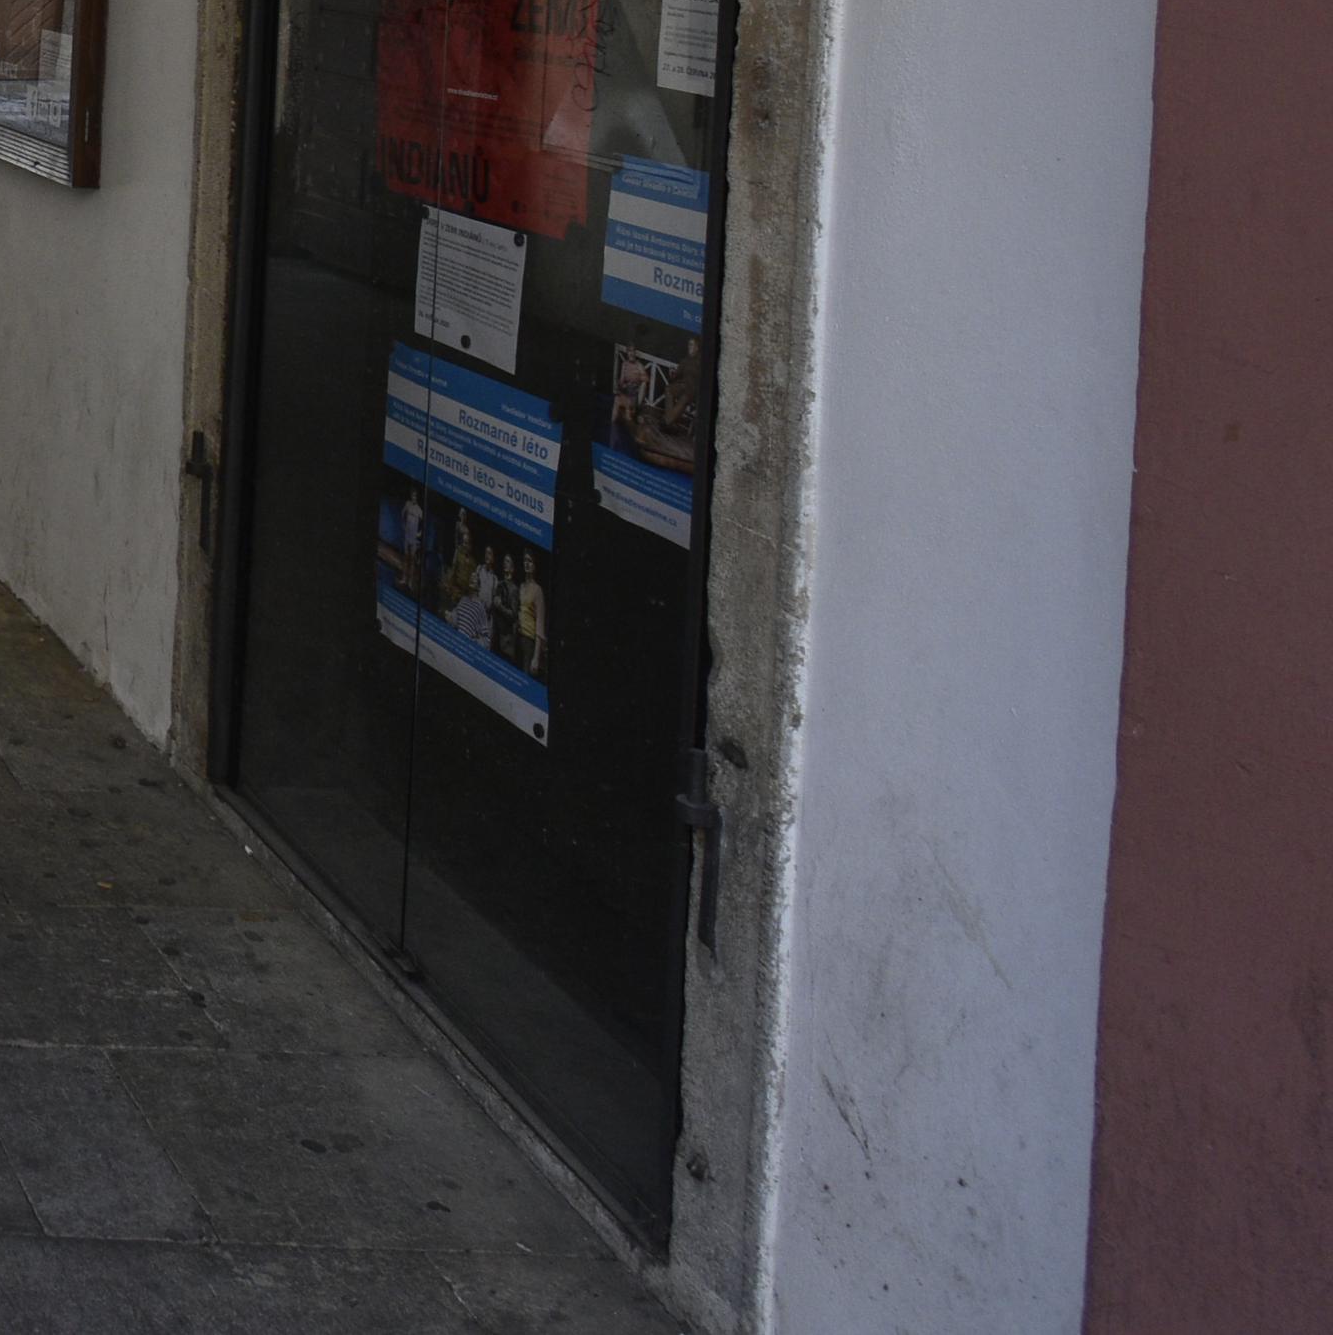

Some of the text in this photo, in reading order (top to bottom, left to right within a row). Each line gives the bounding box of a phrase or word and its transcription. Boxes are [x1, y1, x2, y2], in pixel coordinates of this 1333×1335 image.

[459, 409, 518, 447] Rozmarné
[522, 436, 549, 460] léto
[417, 438, 470, 476] Rzmarné
[473, 463, 496, 489] léto
[506, 481, 545, 514] bonus
